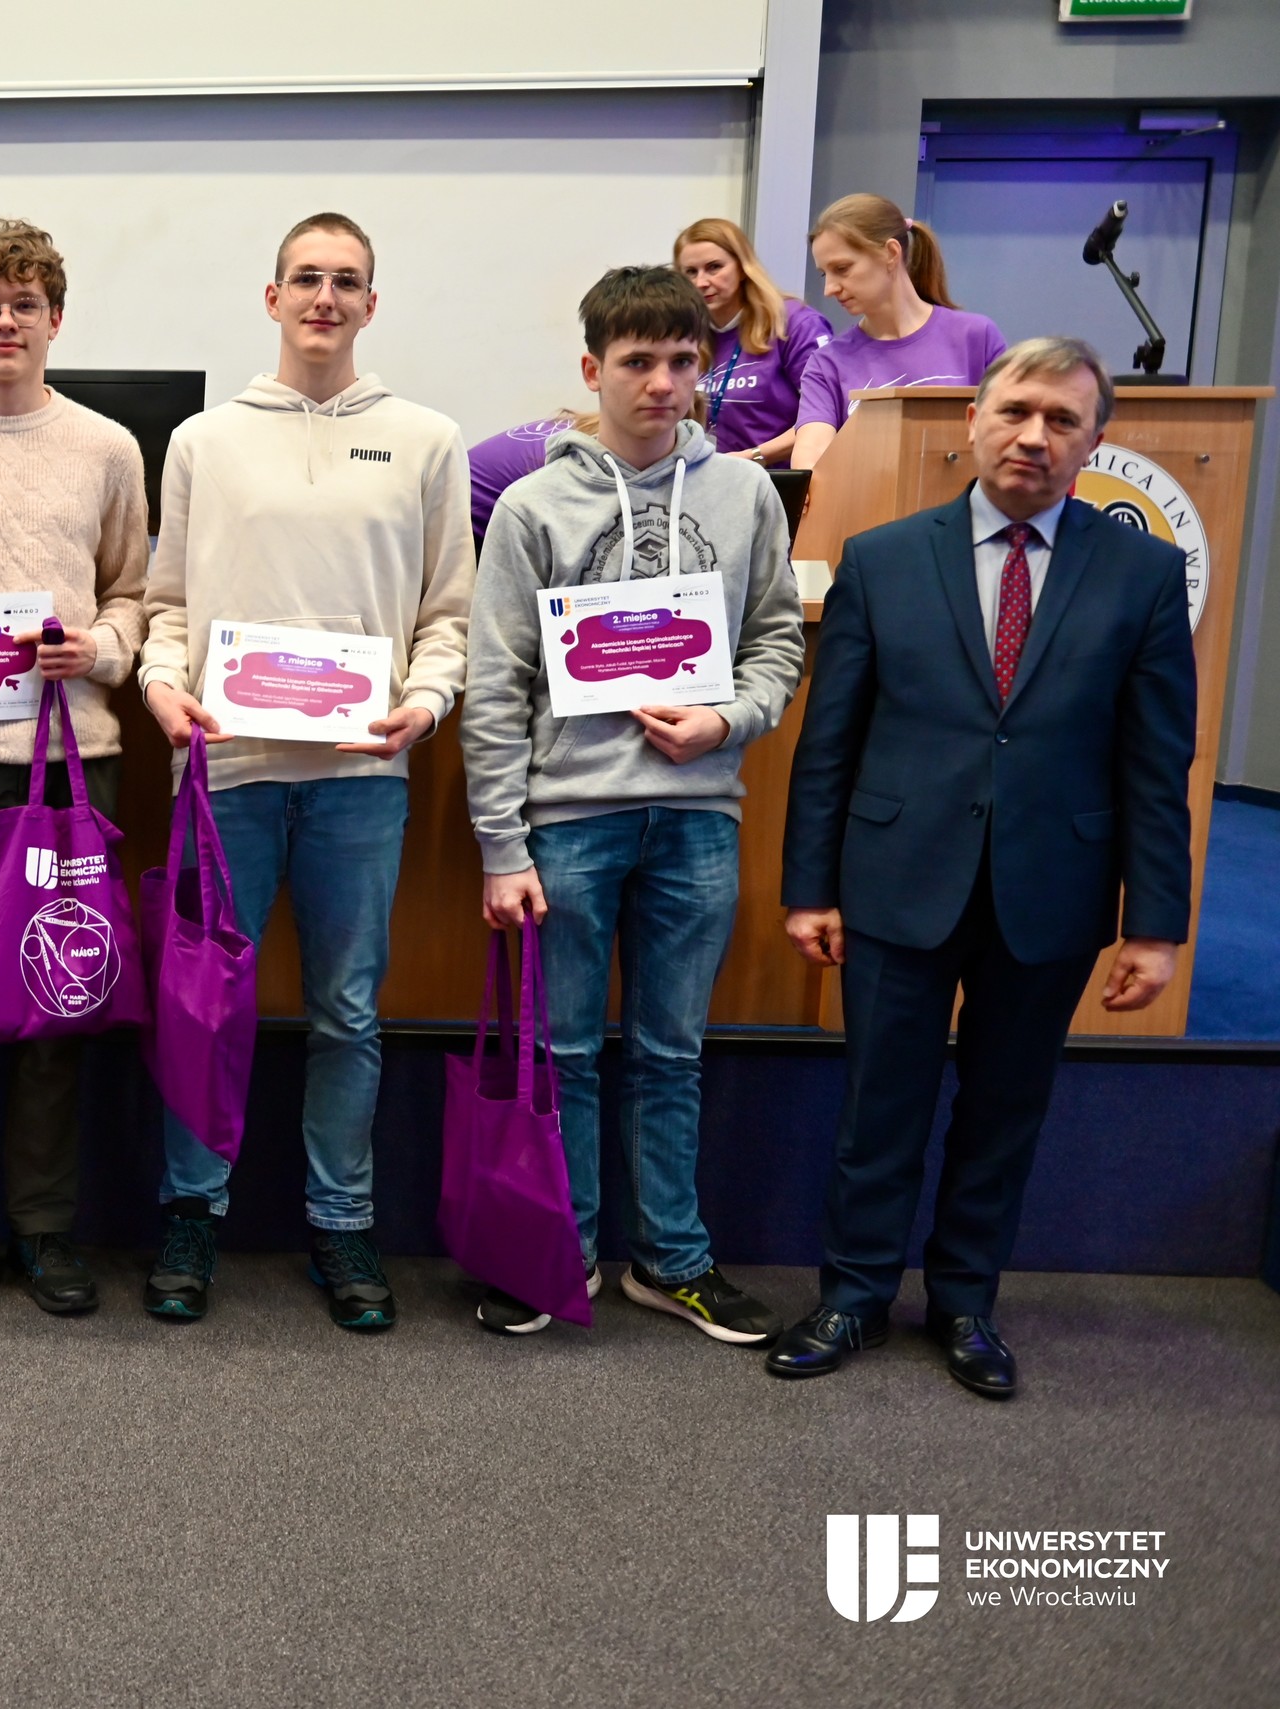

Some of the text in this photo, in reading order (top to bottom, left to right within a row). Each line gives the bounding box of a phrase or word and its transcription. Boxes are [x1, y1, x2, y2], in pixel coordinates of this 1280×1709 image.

[706, 376, 757, 393] BOJ
[350, 448, 391, 463] PUMA
[1163, 497, 1190, 529] IN
[632, 518, 655, 530] ceum
[613, 612, 658, 624] 2. miejsce
[288, 657, 323, 667] miejsce
